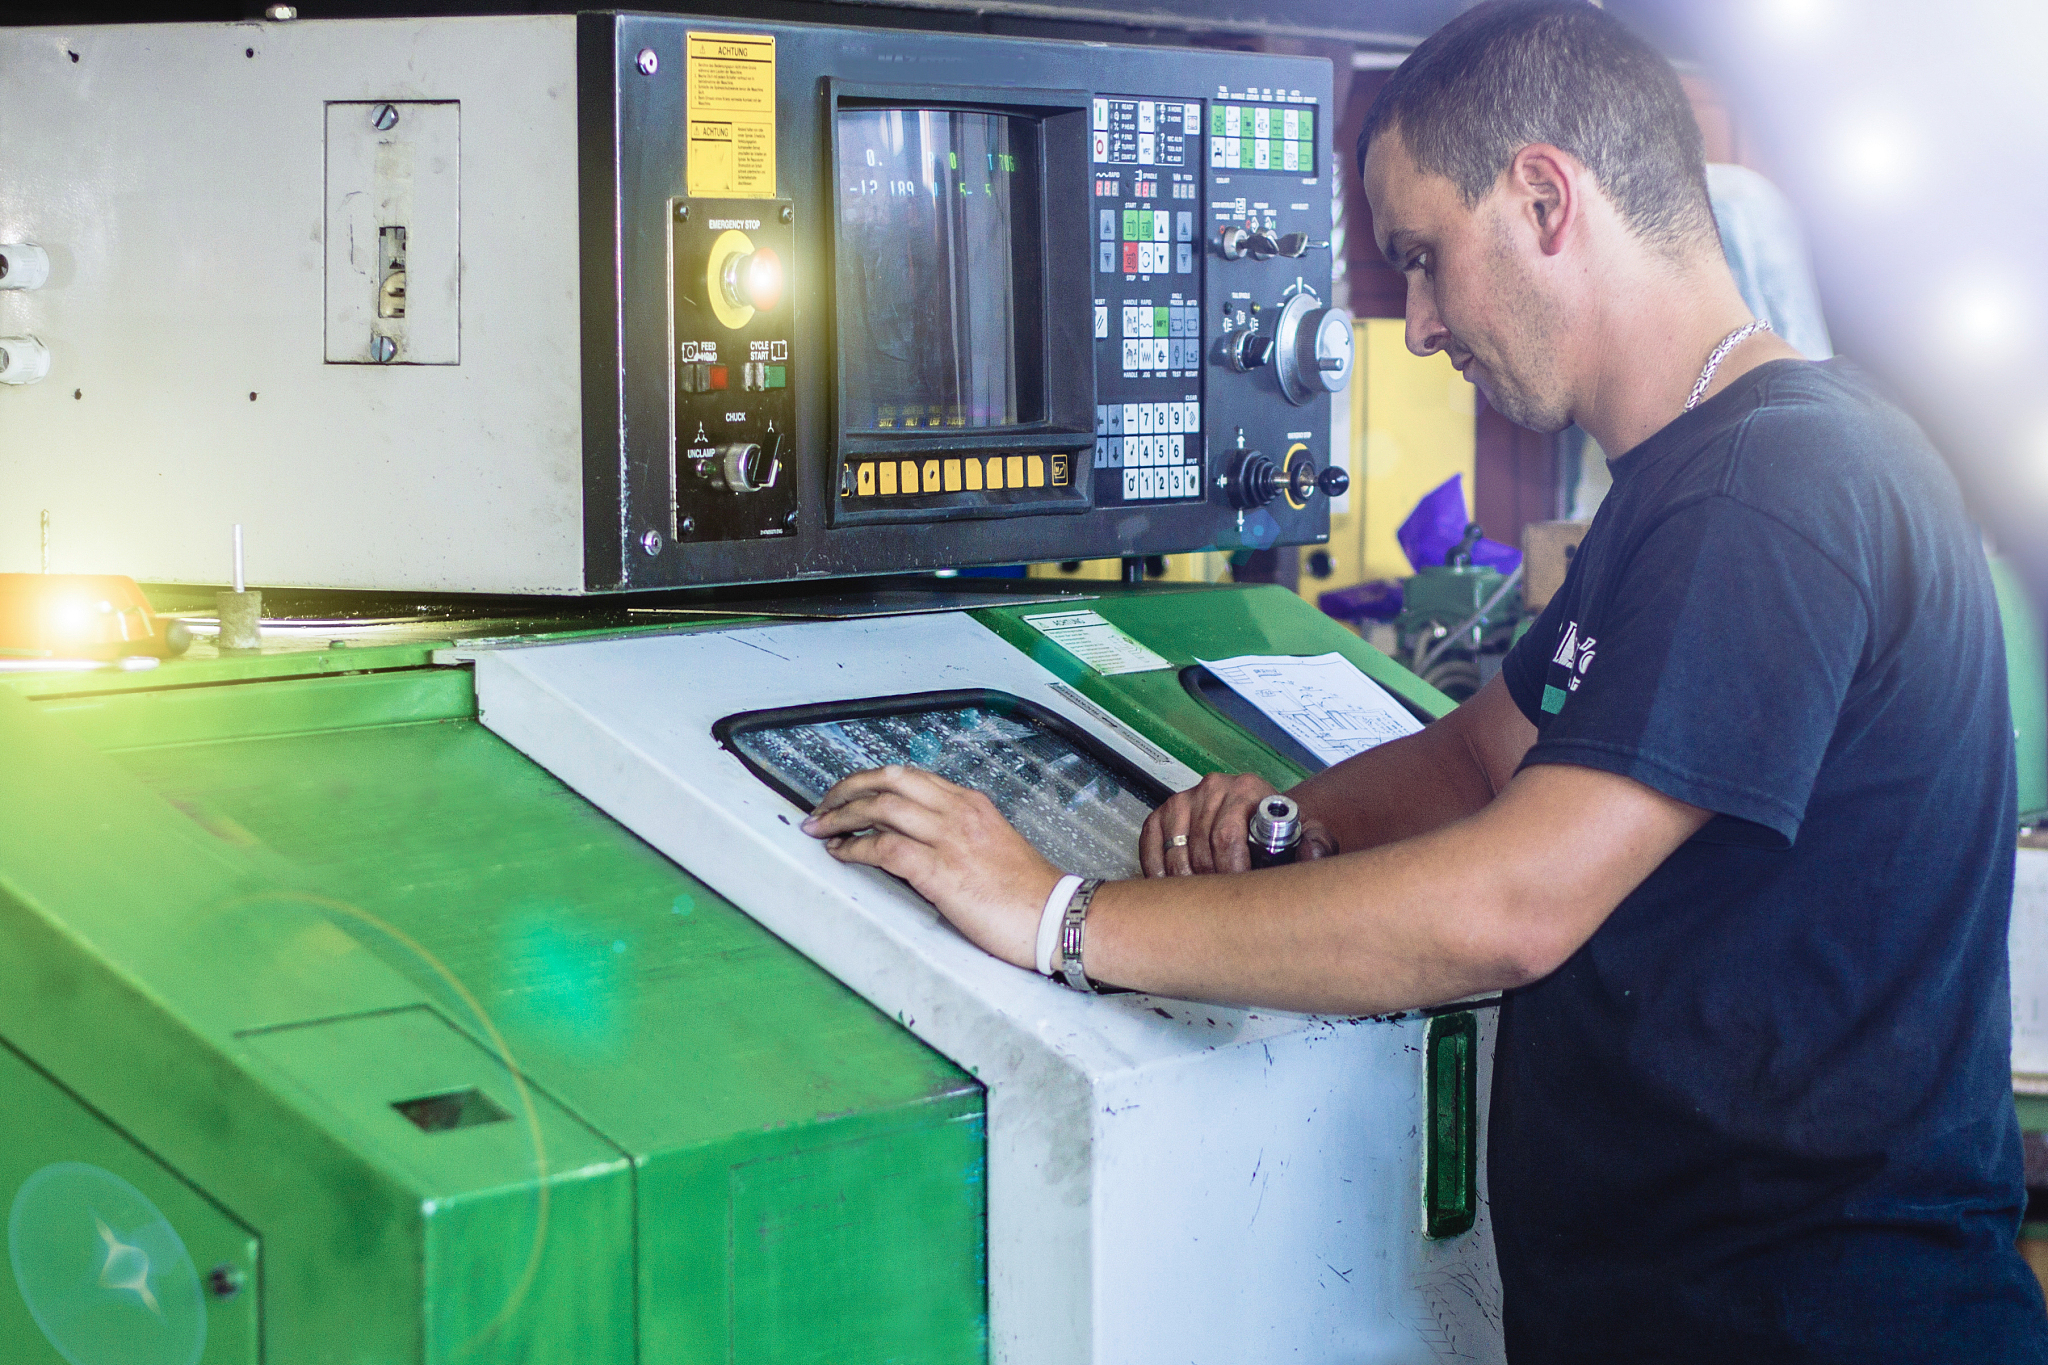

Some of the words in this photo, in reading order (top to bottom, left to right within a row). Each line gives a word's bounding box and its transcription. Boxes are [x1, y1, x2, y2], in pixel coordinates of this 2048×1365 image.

[718, 46, 748, 57] ACHTUNG
[703, 127, 728, 137] ACHTUNG
[949, 152, 957, 169] 0
[708, 220, 744, 230] EMERGENCY
[745, 220, 760, 230] STOP
[701, 342, 716, 351] FEED
[750, 341, 769, 350] CYCLE
[750, 351, 769, 361] START
[726, 412, 746, 422] CHUCK
[1144, 413, 1149, 426] 7
[1159, 412, 1164, 426] 8
[1174, 411, 1180, 425] 9
[687, 448, 716, 458] UNCLAMP
[1144, 445, 1149, 458] 4
[1159, 445, 1164, 458] 5
[1174, 444, 1179, 458] 6
[1128, 478, 1134, 492] 0
[1145, 477, 1149, 490] 1
[1160, 476, 1164, 490] 2
[1174, 476, 1180, 489] 3
